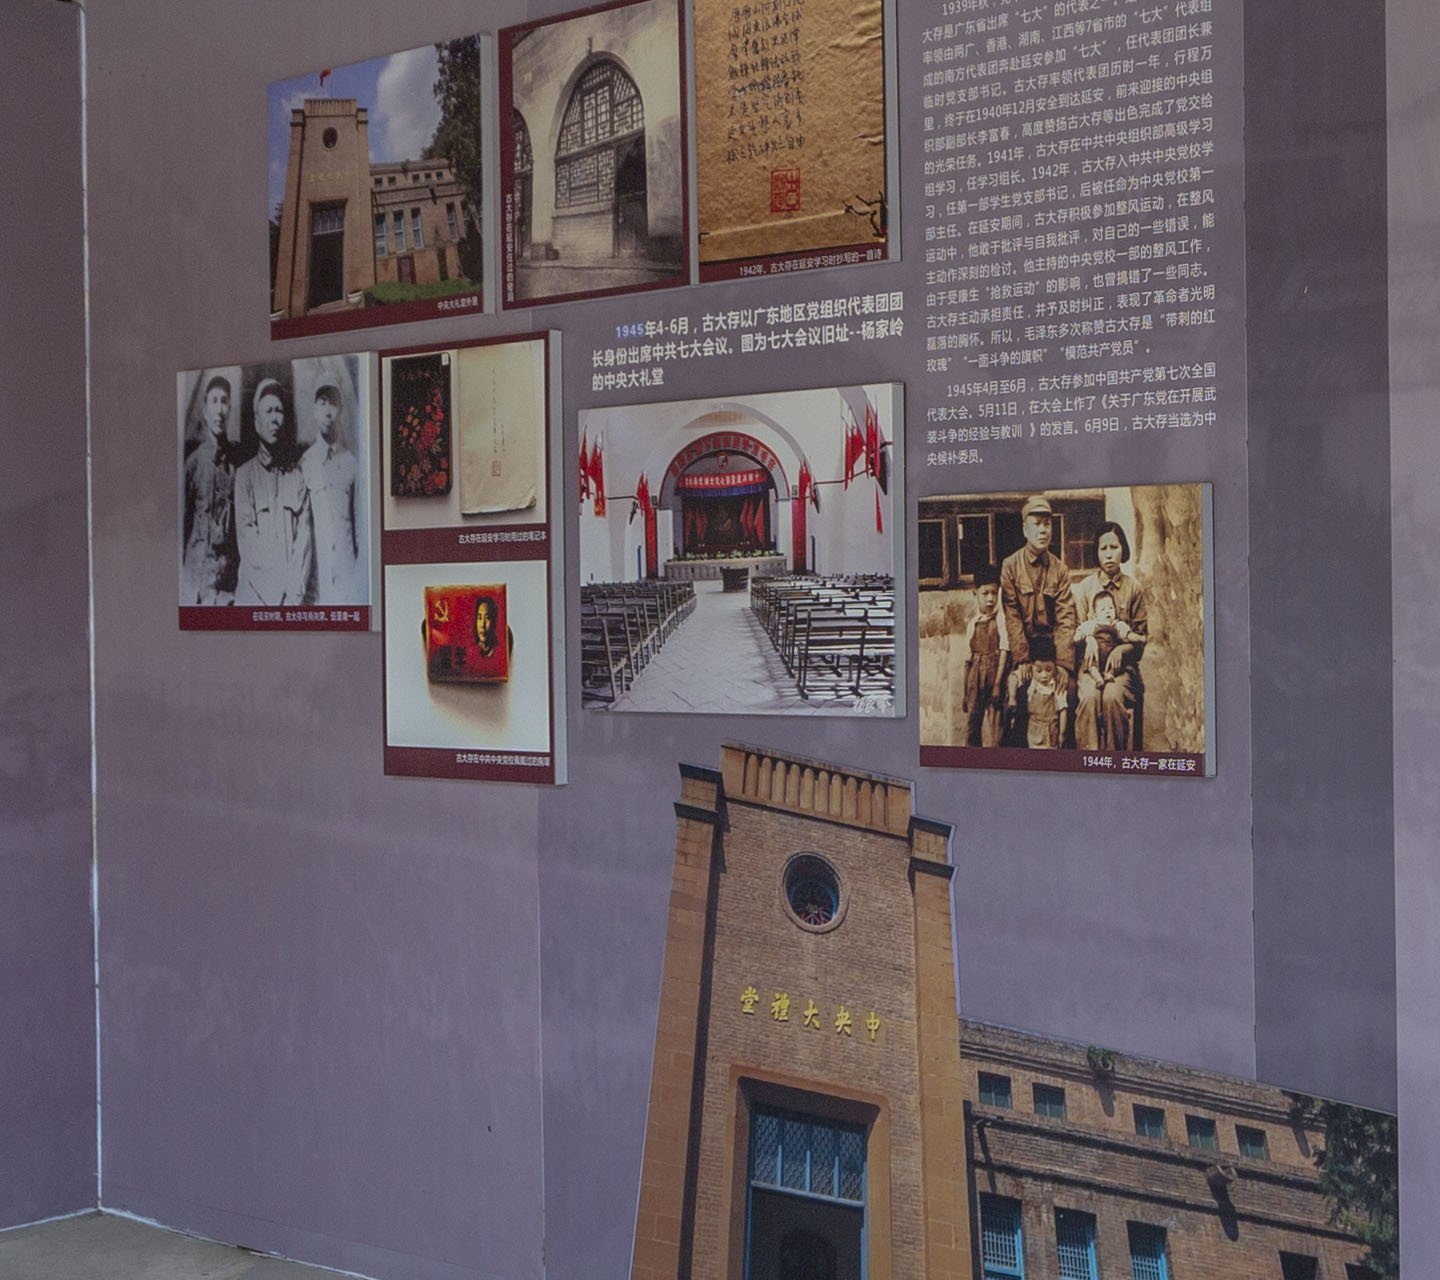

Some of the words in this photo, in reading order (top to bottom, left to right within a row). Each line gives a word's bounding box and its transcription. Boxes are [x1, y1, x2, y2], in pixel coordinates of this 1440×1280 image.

[615, 292, 904, 339] 1945年4-6月，古大存以广东地区党组织代表团团
[591, 368, 664, 391] 的中央大礼堂
[926, 448, 983, 466] 央候补委员。
[1082, 755, 1196, 772] 1944年，古大存一家在延安
